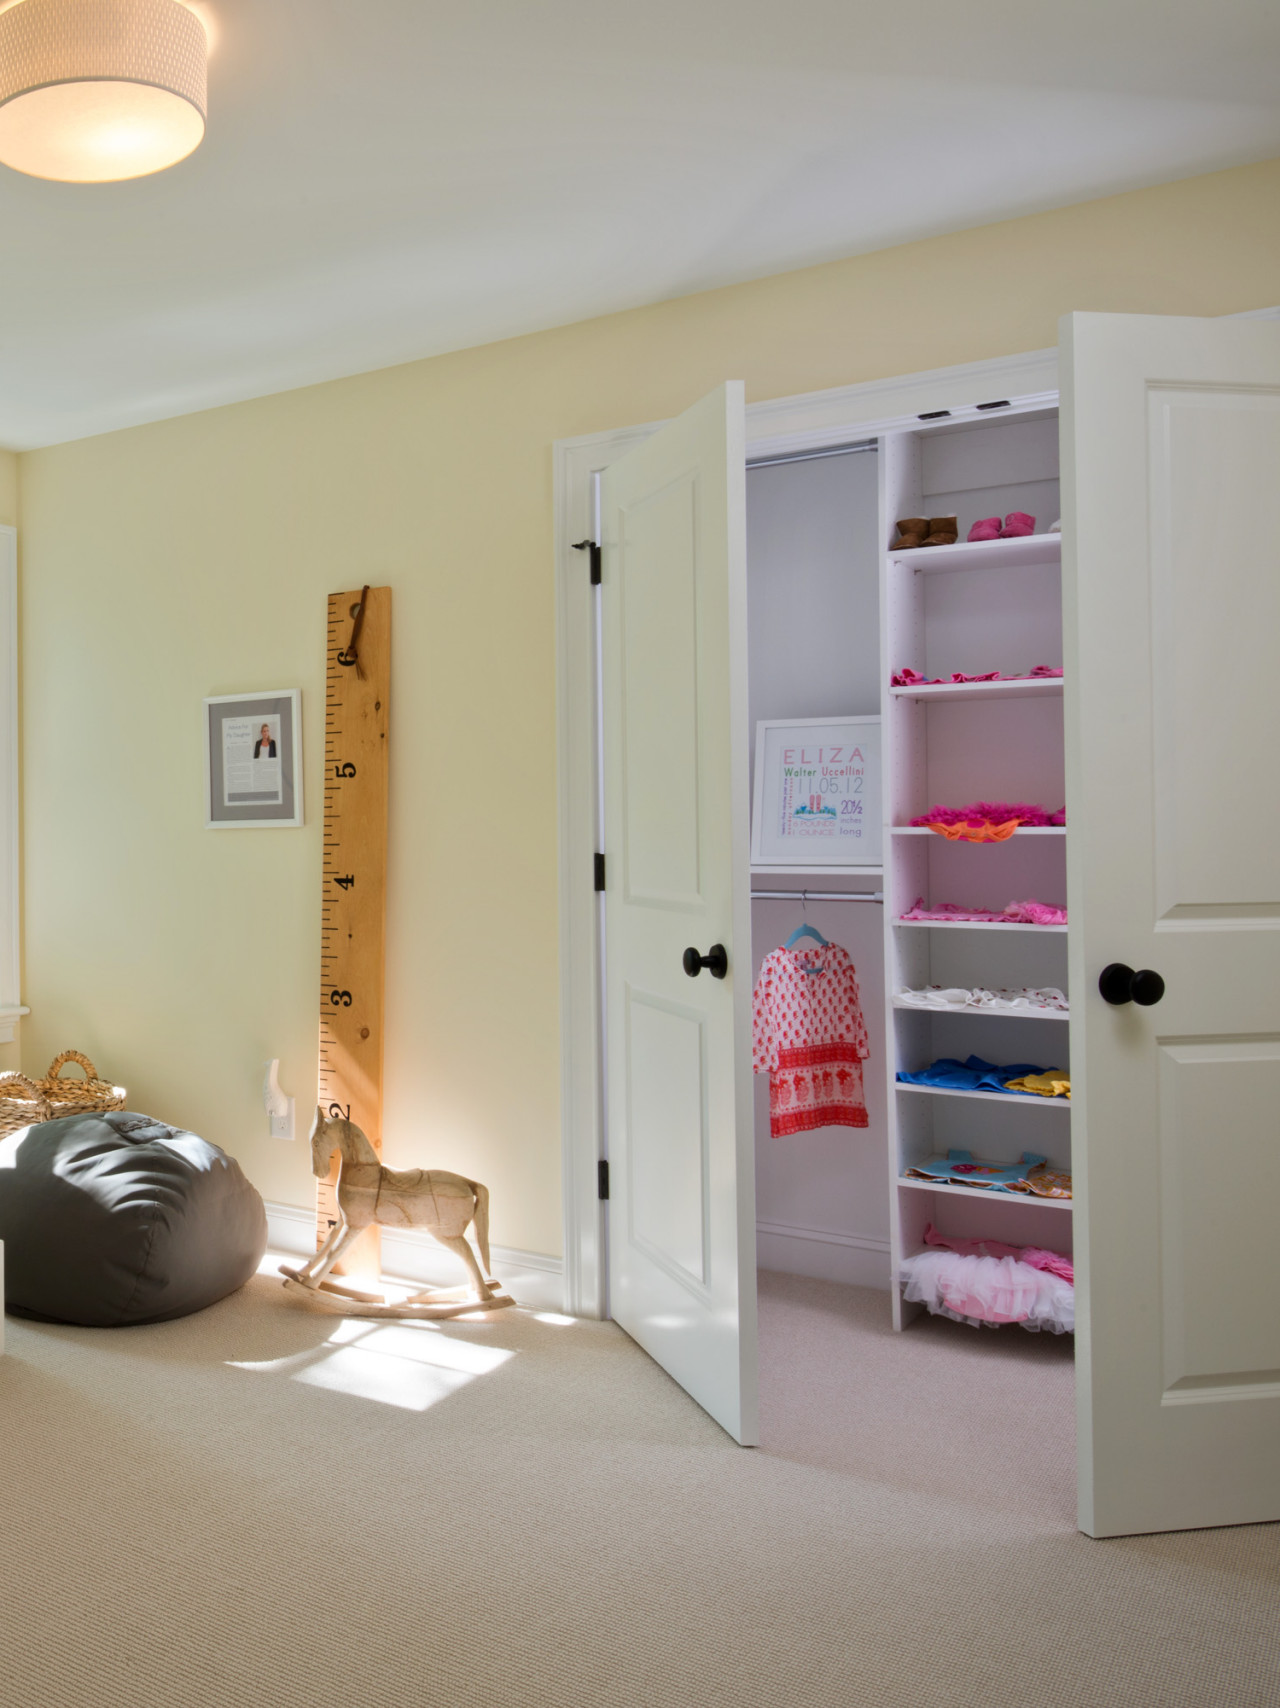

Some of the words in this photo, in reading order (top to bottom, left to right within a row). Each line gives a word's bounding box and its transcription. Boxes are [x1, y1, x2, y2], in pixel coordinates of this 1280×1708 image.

[784, 747, 865, 764] ELIZA
[335, 762, 356, 778] 5
[784, 767, 817, 777] Walter
[822, 765, 865, 776] Uccellini
[798, 776, 863, 794] 11.05.12
[840, 827, 862, 838] long
[334, 874, 354, 890] 4
[330, 990, 352, 1007] 3
[329, 1103, 350, 1120] 2
